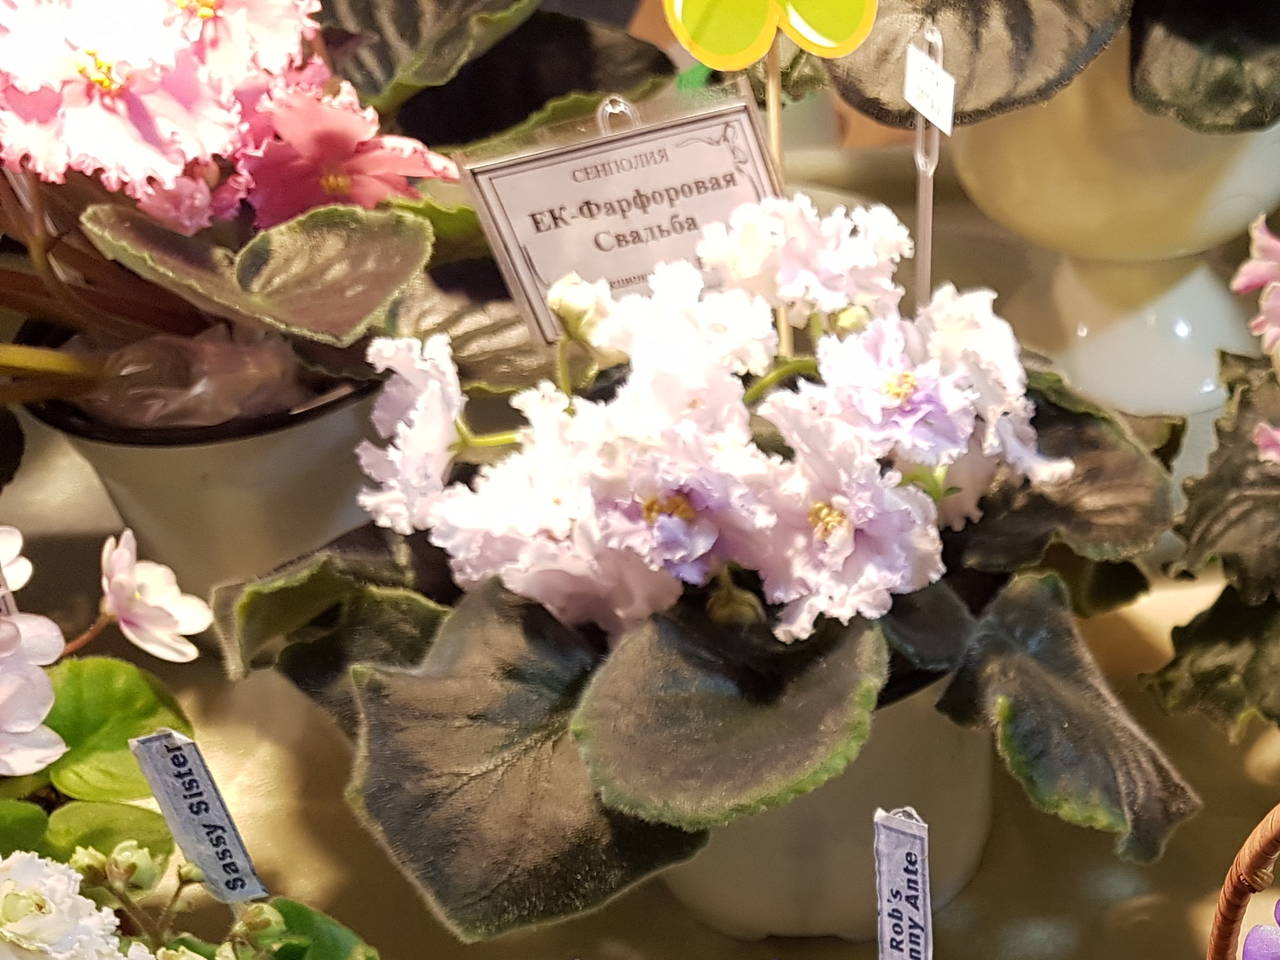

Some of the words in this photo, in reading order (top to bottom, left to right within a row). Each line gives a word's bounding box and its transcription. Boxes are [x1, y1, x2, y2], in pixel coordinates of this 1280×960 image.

[572, 148, 670, 184] СЕНПОЛИЯ
[528, 171, 738, 234] ЕК-Фарфоровая
[593, 214, 700, 253] Свадьба
[163, 743, 211, 817] Sister
[201, 822, 247, 892] Sassy
[903, 851, 920, 911] Ante
[886, 888, 905, 953] Rob's
